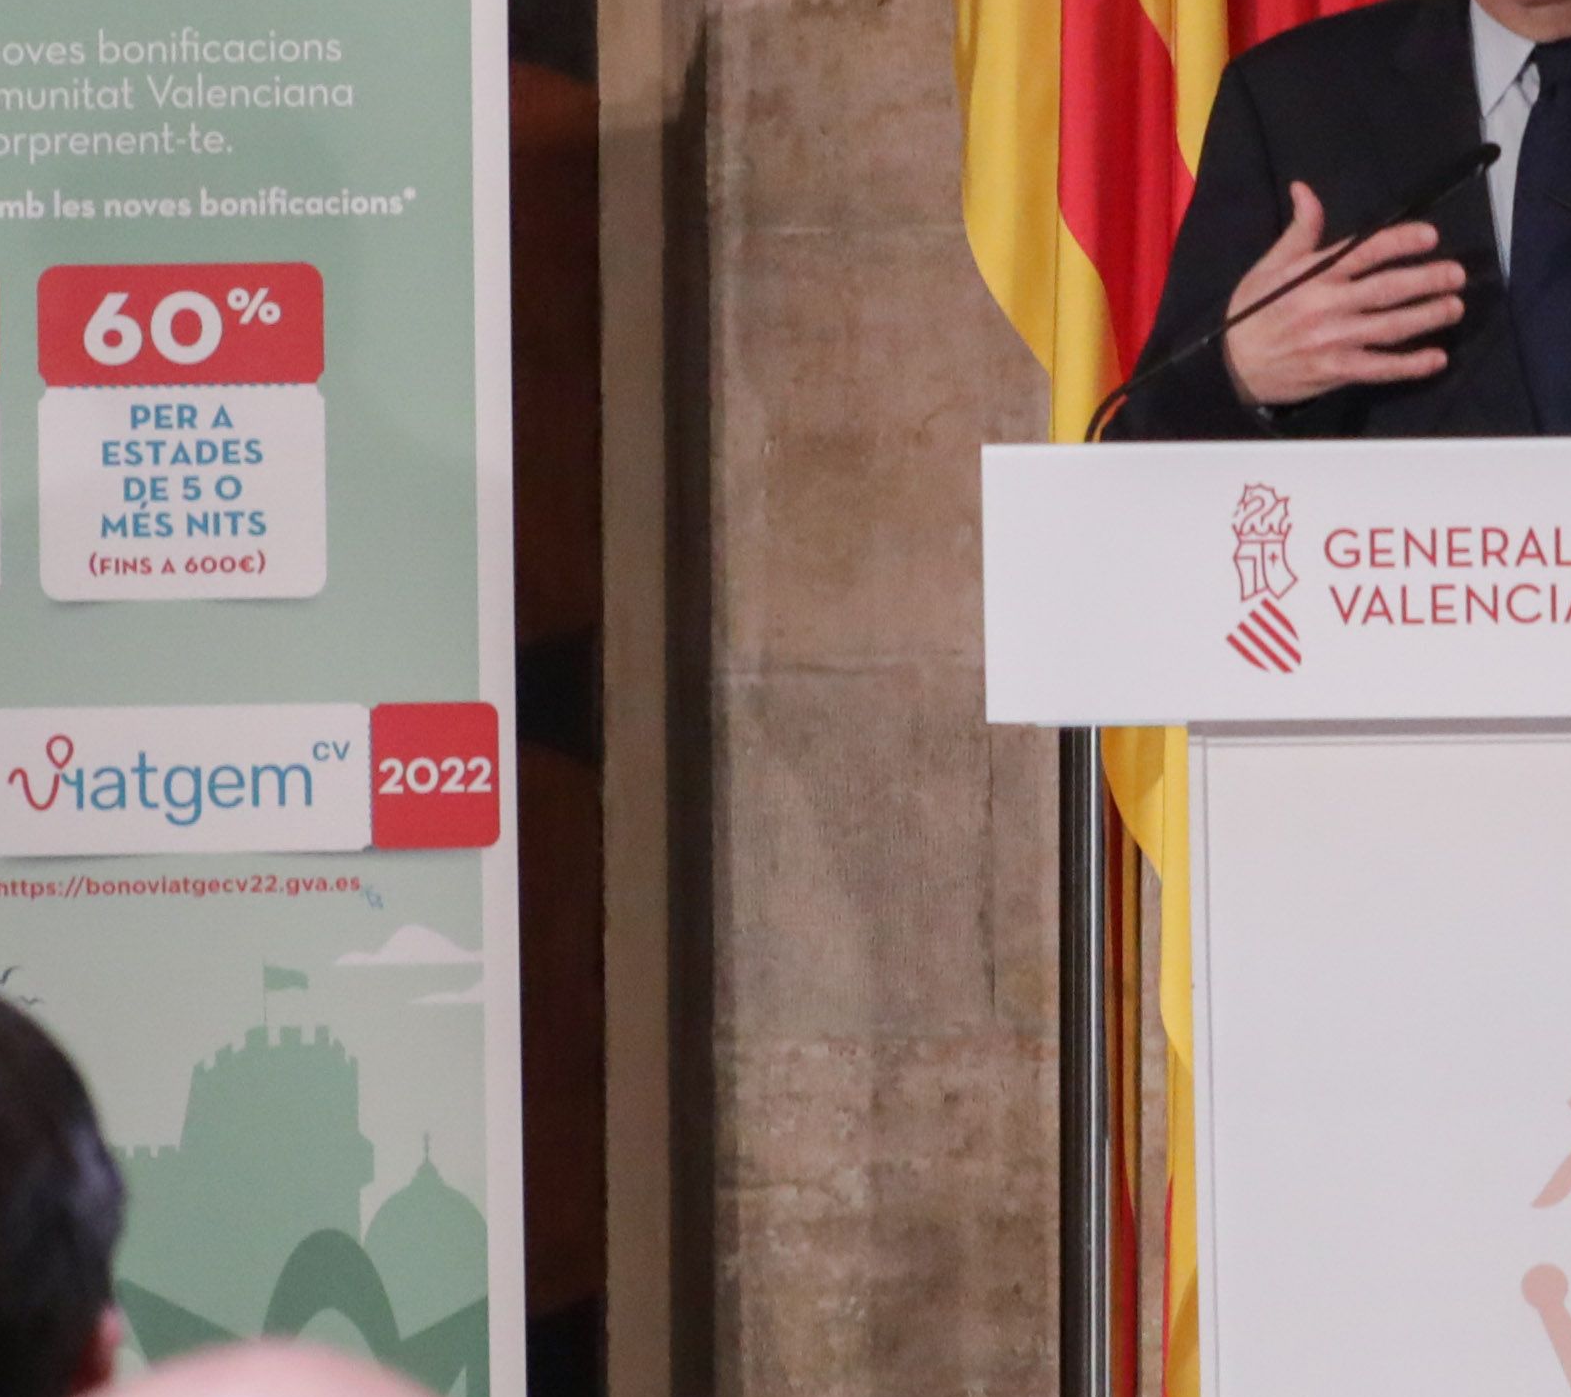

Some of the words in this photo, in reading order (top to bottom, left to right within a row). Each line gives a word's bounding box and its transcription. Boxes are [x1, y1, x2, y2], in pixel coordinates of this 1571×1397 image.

[99, 27, 342, 63] bonificacions
[147, 73, 353, 108] Valenciana
[54, 190, 95, 218] les
[104, 198, 191, 217] noves
[84, 288, 281, 365] 60%
[131, 404, 197, 429] PER
[212, 406, 233, 428] A
[102, 439, 263, 466] ESTADES
[124, 477, 168, 505] DE
[183, 476, 201, 501] 5
[101, 503, 173, 538] MÉS
[187, 511, 266, 537] NITS
[89, 553, 152, 576] (FINS
[162, 559, 175, 574] A
[185, 551, 265, 574] 600€)
[380, 757, 491, 793] 2022
